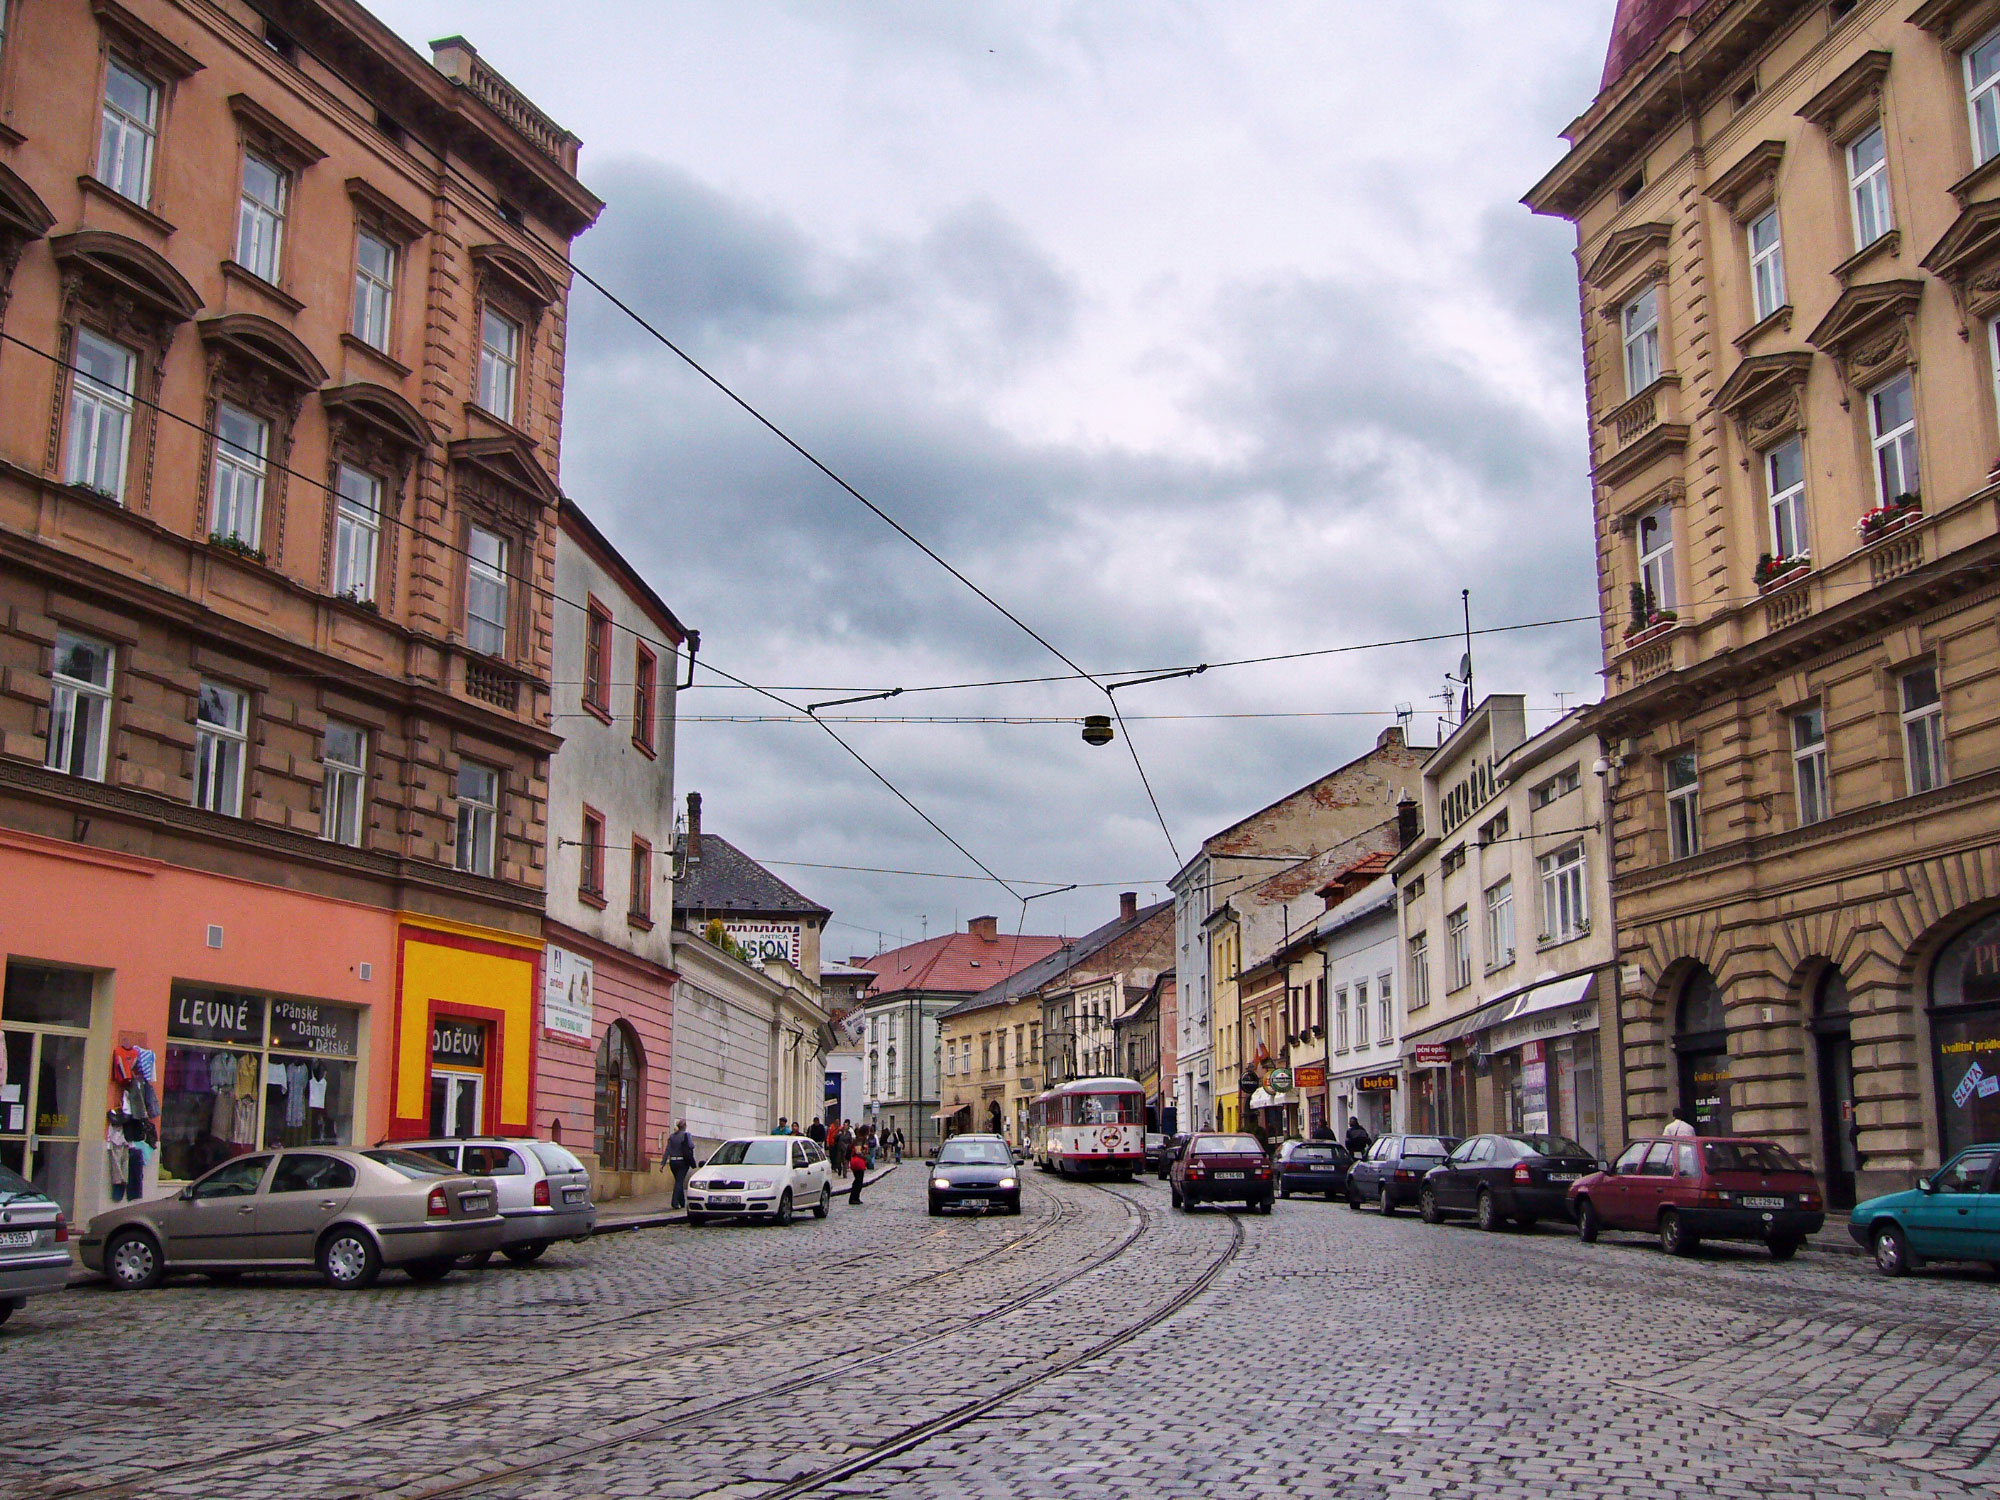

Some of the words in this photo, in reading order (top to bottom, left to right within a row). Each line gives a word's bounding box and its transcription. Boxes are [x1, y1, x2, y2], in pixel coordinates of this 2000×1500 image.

[1441, 755, 1504, 834] CUKRÁRN
[179, 999, 249, 1031] LEVNÉ
[283, 1003, 319, 1021] Pánské
[298, 1023, 337, 1039] Dámské
[433, 1027, 481, 1056] ODĚVY
[315, 1039, 349, 1055] Dětské
[1363, 1077, 1394, 1088] bufet
[1954, 1067, 1983, 1107] SLEVA
